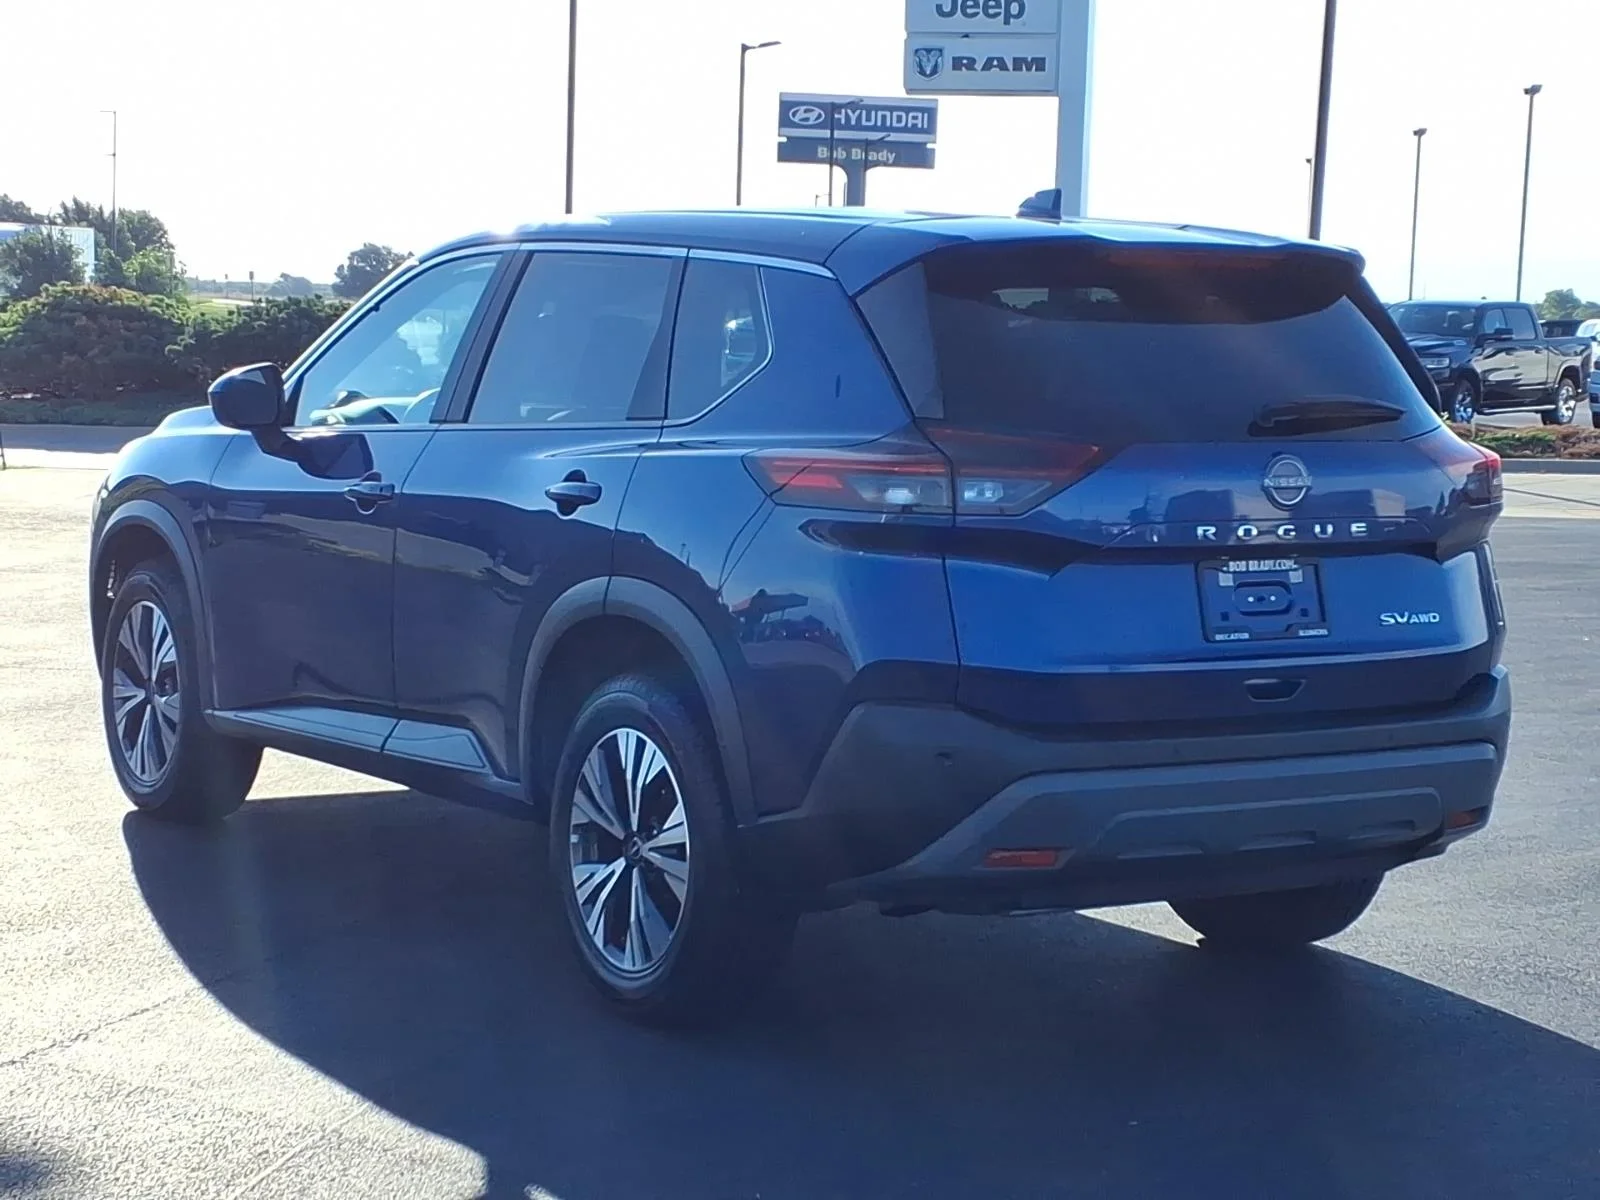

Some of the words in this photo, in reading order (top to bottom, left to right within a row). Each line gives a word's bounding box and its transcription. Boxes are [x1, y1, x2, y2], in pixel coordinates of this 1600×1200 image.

[936, 0, 1026, 26] Jeep
[951, 56, 1047, 72] RAM
[1263, 476, 1312, 487] NISSAN
[1196, 522, 1369, 541] ROGUE
[1380, 611, 1407, 625] SV
[1409, 612, 1440, 624] AWD
